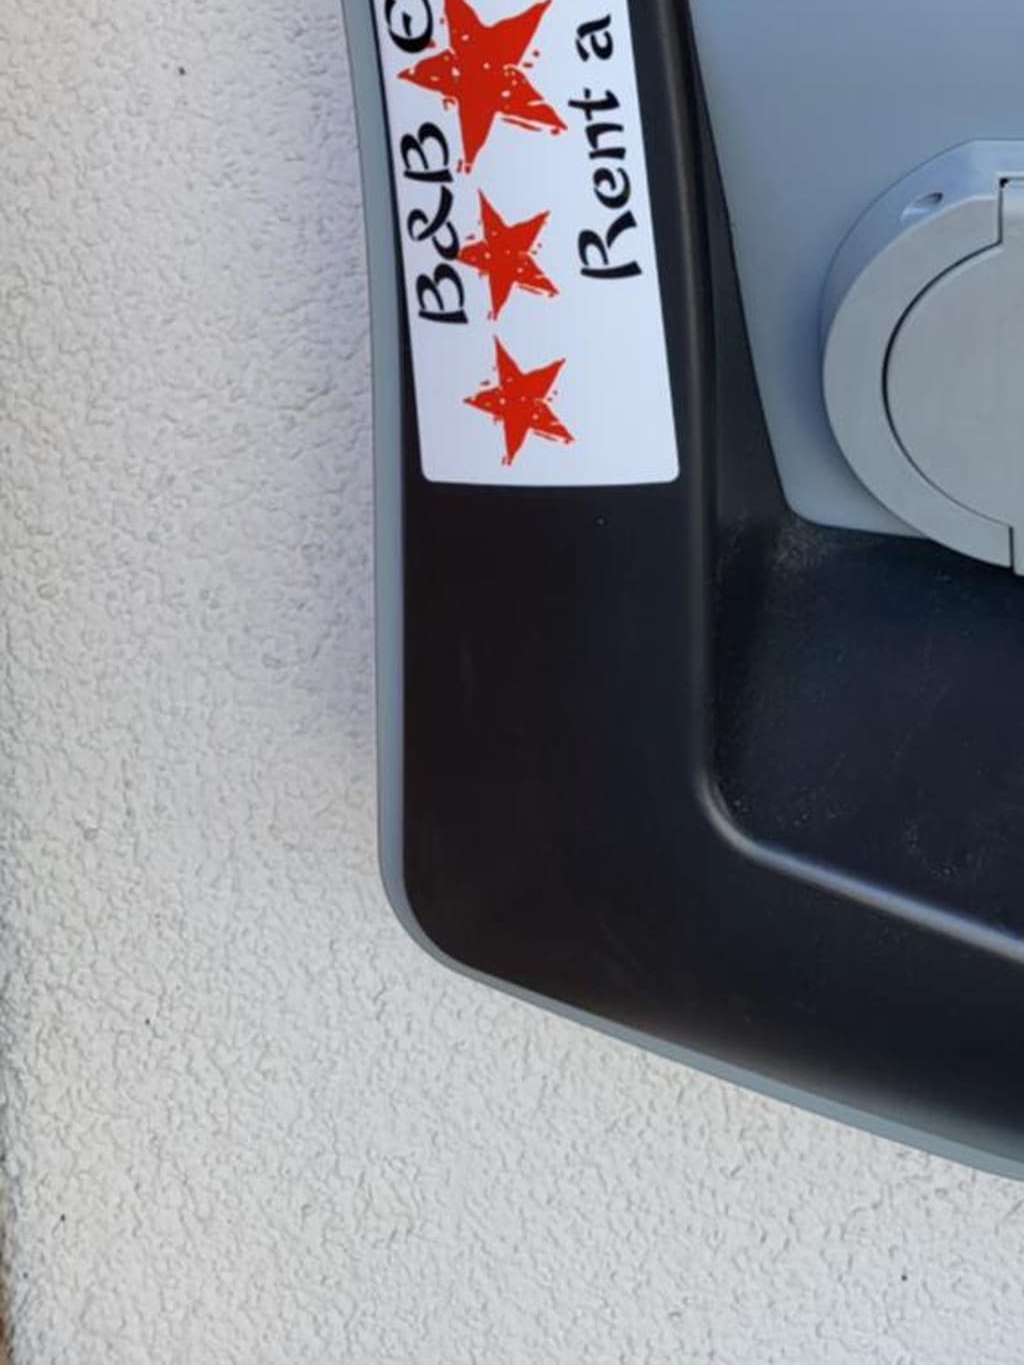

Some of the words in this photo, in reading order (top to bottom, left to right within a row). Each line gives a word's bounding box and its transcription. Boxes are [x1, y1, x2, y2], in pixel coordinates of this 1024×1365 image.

[575, 13, 613, 62] a
[400, 122, 469, 324] B&B
[568, 88, 643, 279] Rent
